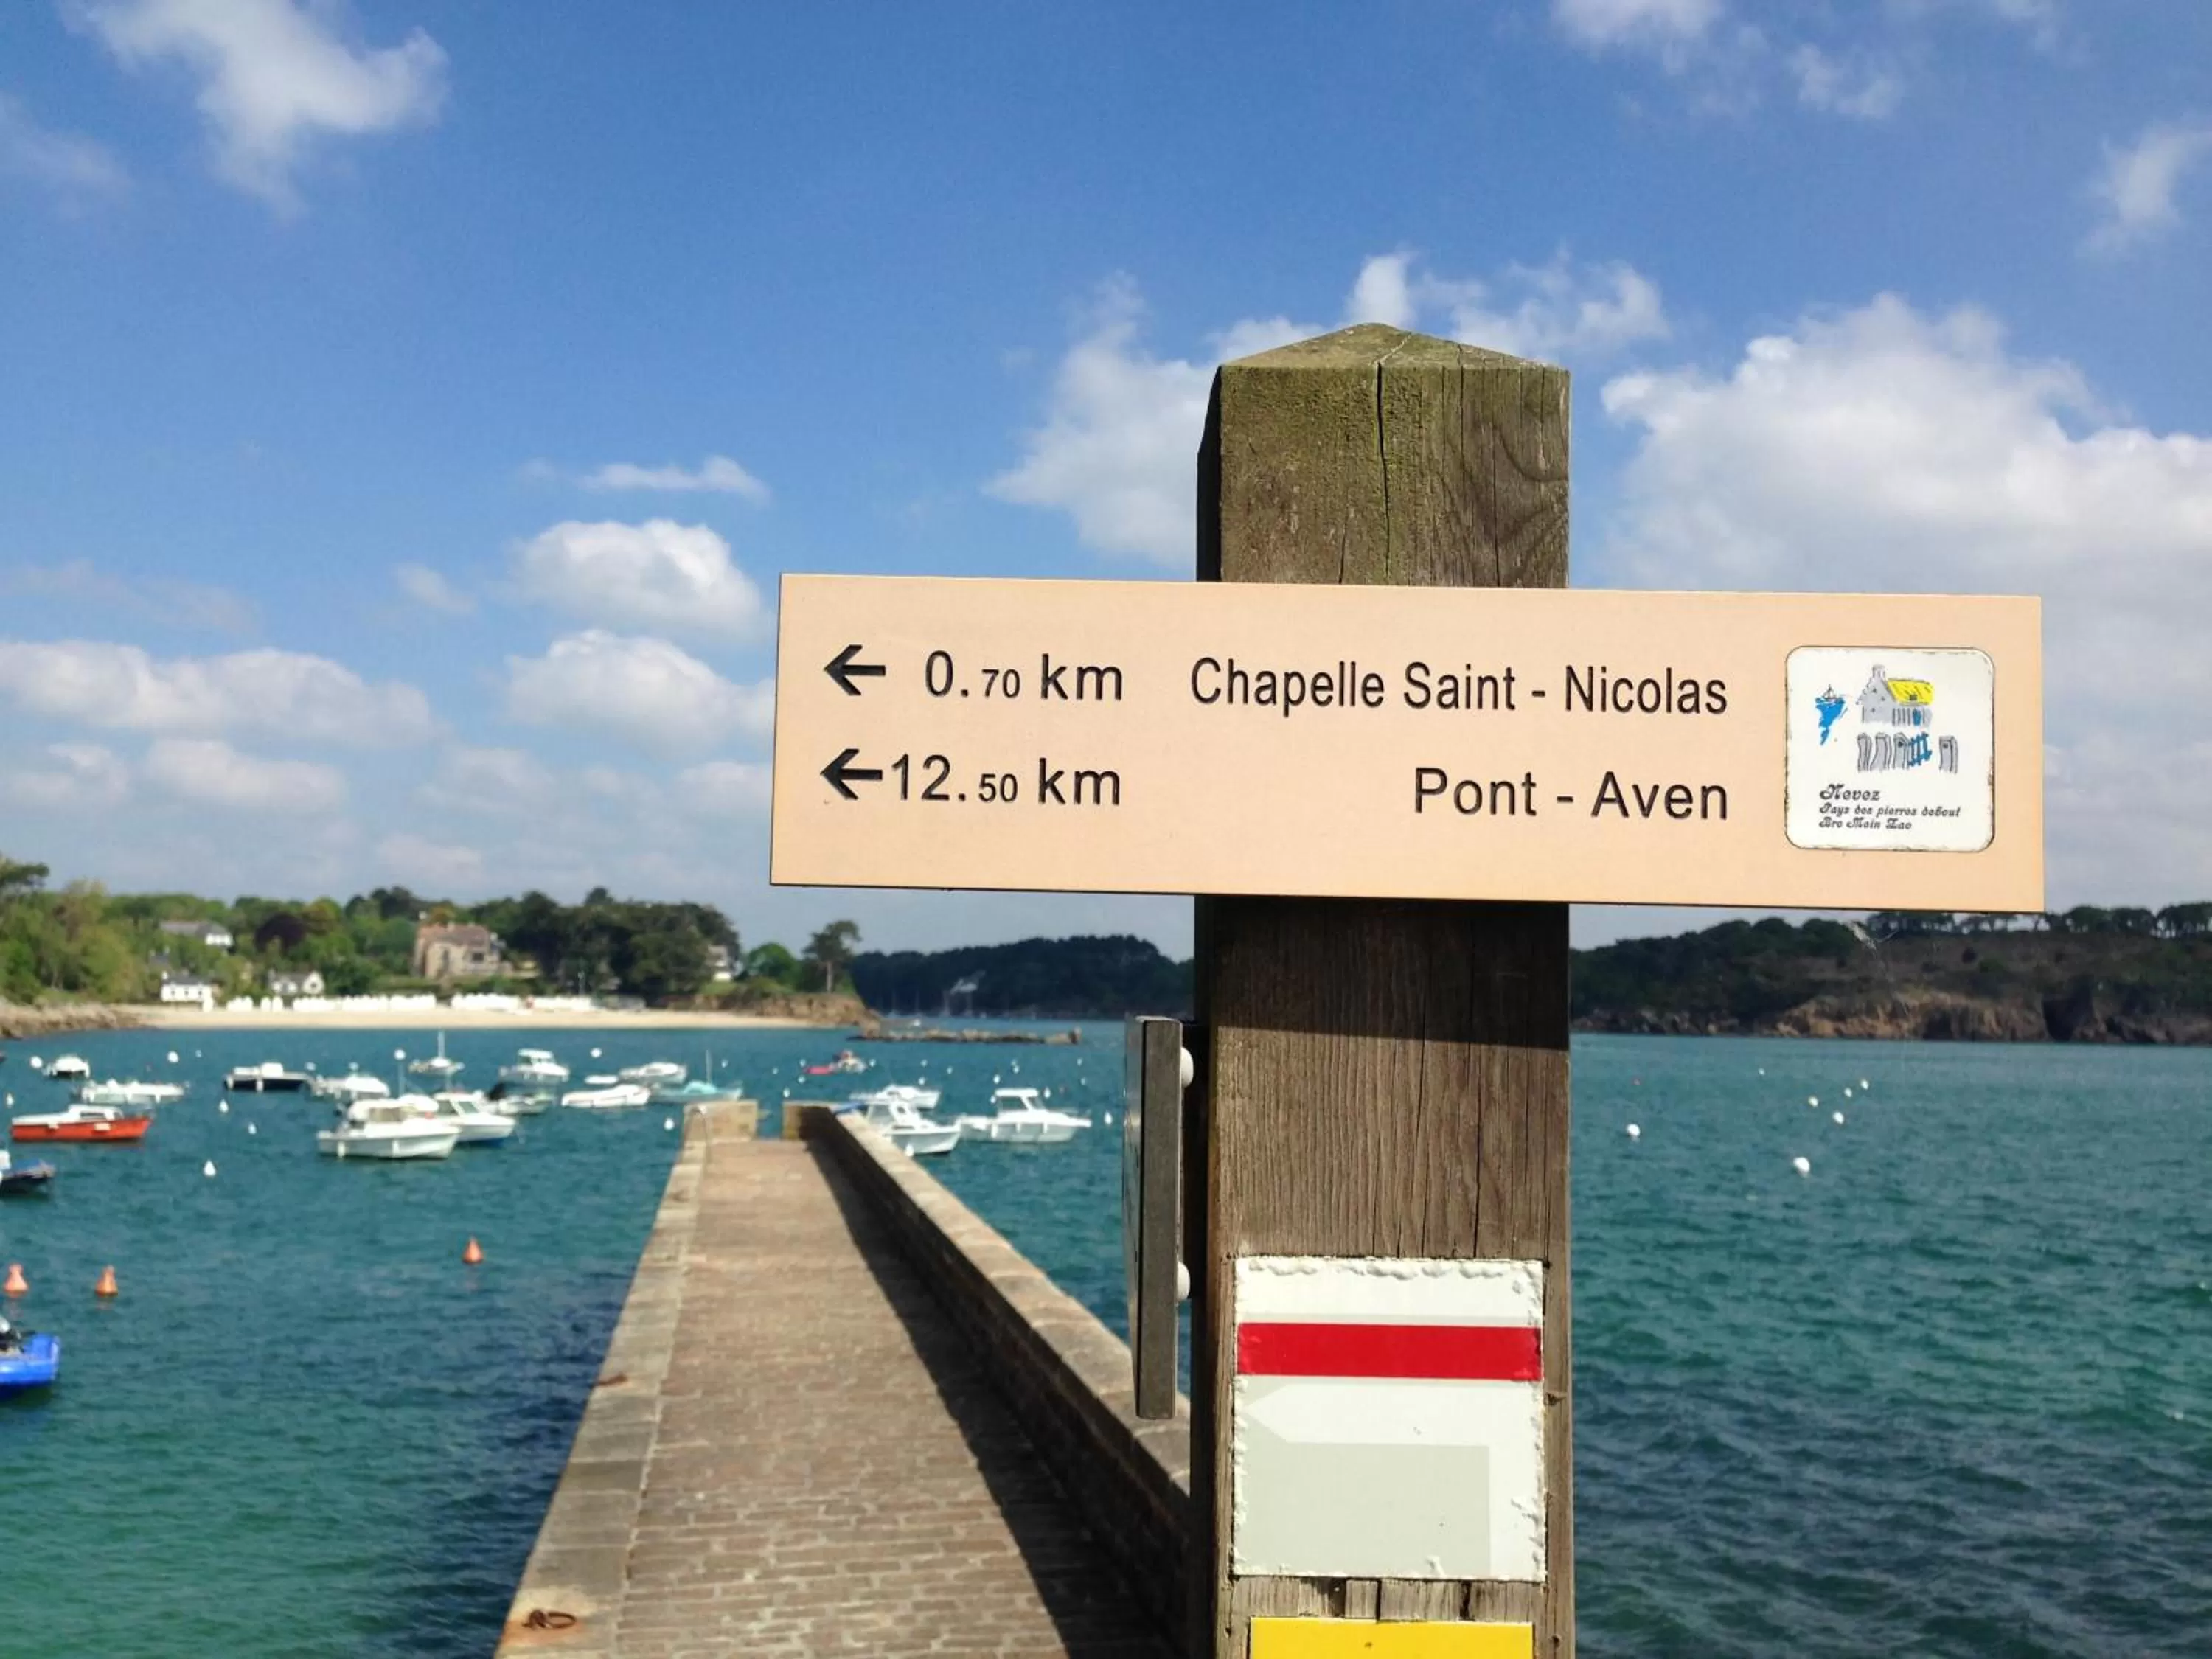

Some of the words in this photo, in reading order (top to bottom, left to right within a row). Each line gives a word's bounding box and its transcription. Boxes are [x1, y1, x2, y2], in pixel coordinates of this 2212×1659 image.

[925, 650, 1020, 698] 0.70
[1040, 653, 1122, 701] km
[1191, 657, 1385, 718] Chapelle
[1403, 661, 1515, 711] Saint
[1565, 665, 1727, 714] Nicolas
[891, 753, 1018, 803] 12.50
[1038, 757, 1120, 806] km
[1415, 767, 1537, 816] Pont
[1591, 771, 1727, 820] Aven
[1819, 802, 1850, 816] Pays
[1854, 804, 1873, 815] des
[1877, 806, 1917, 818] pierres
